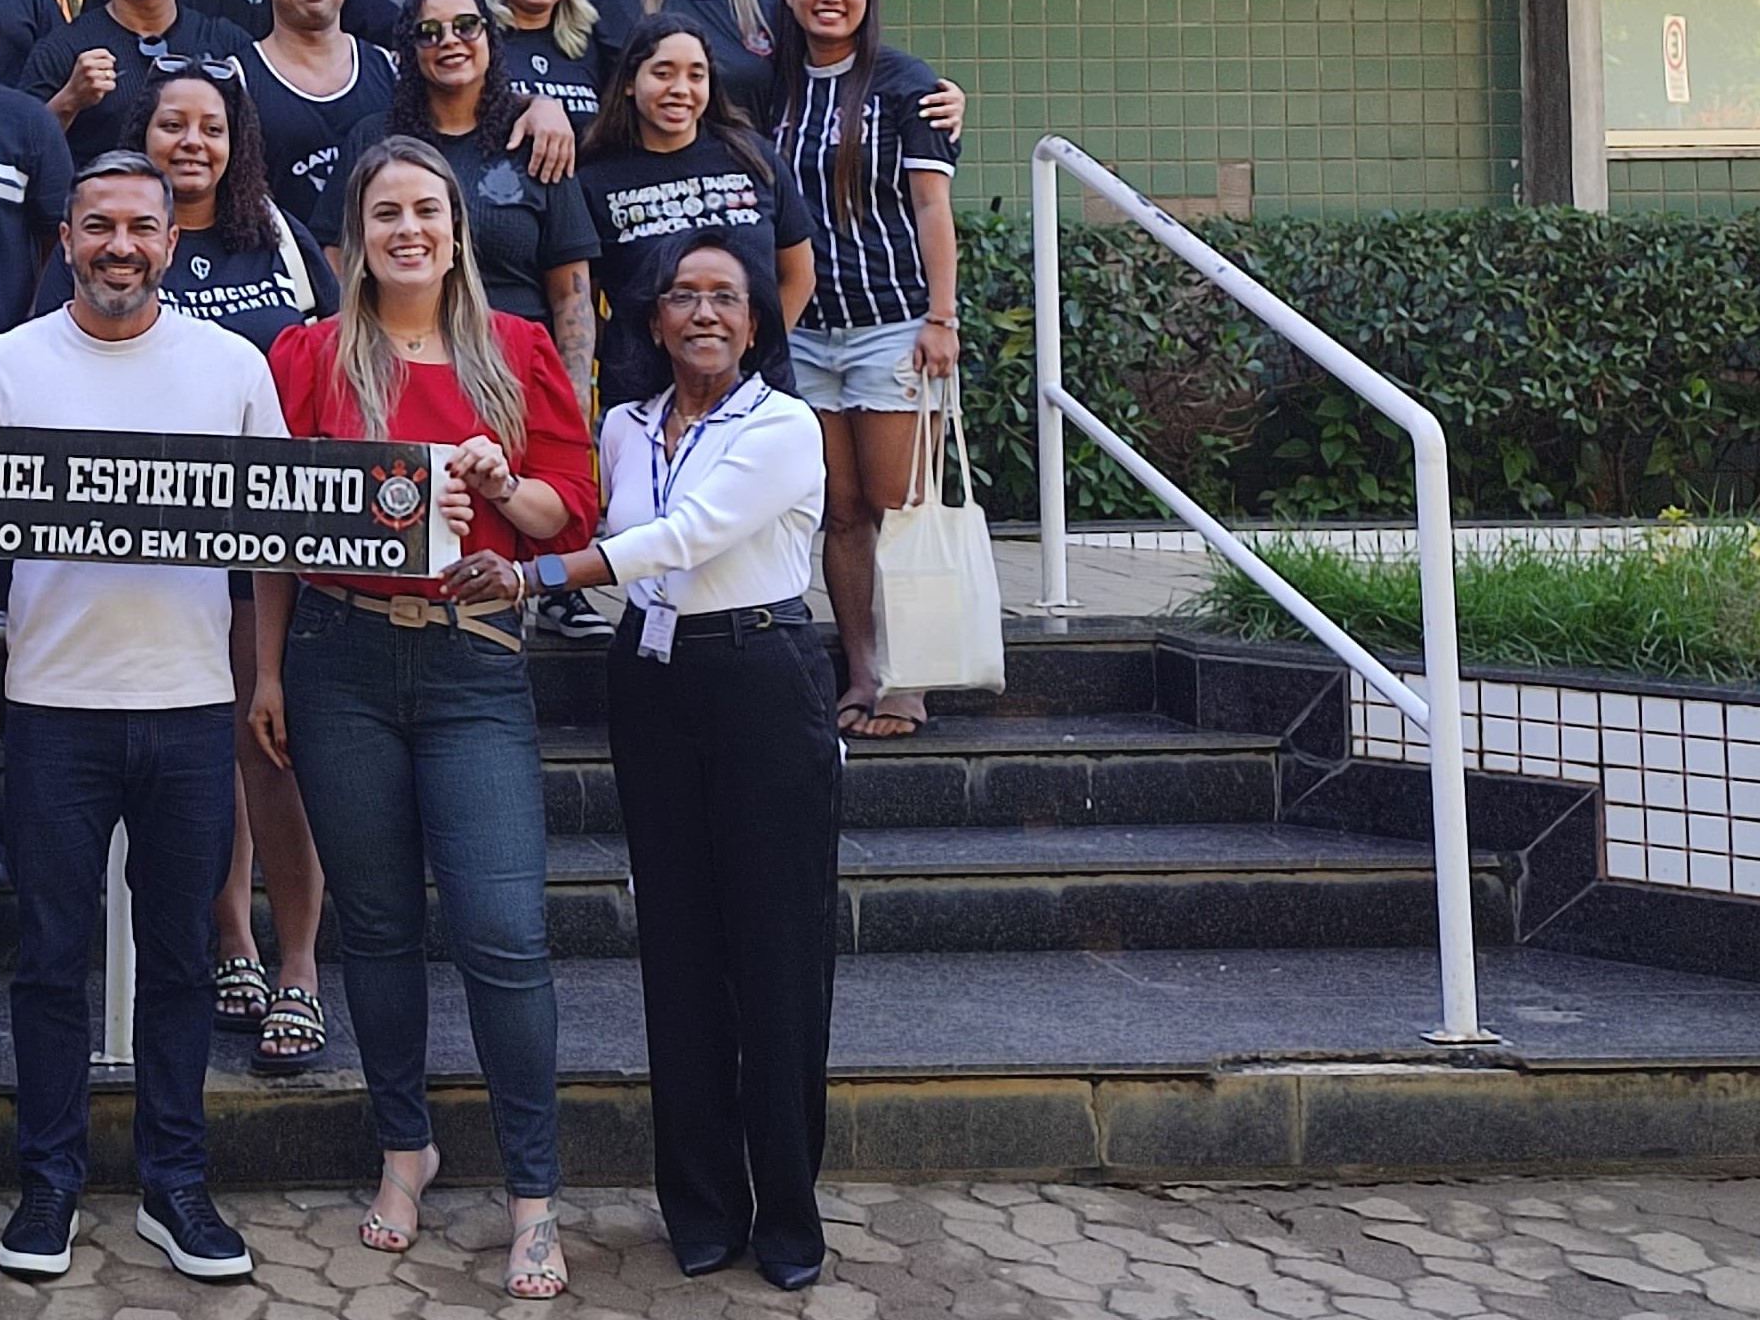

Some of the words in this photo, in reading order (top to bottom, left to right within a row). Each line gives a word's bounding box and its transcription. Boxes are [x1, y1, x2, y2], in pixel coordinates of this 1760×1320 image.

[292, 146, 339, 176] GAVI
[184, 280, 273, 305] TORCIDA
[225, 291, 281, 315] SANTO
[66, 456, 235, 508] ESPIRITO
[247, 464, 364, 513] SANTO
[30, 520, 133, 556] TIMÃO
[141, 529, 187, 559] EM
[195, 531, 286, 563] TODO
[295, 536, 406, 567] CANTO
